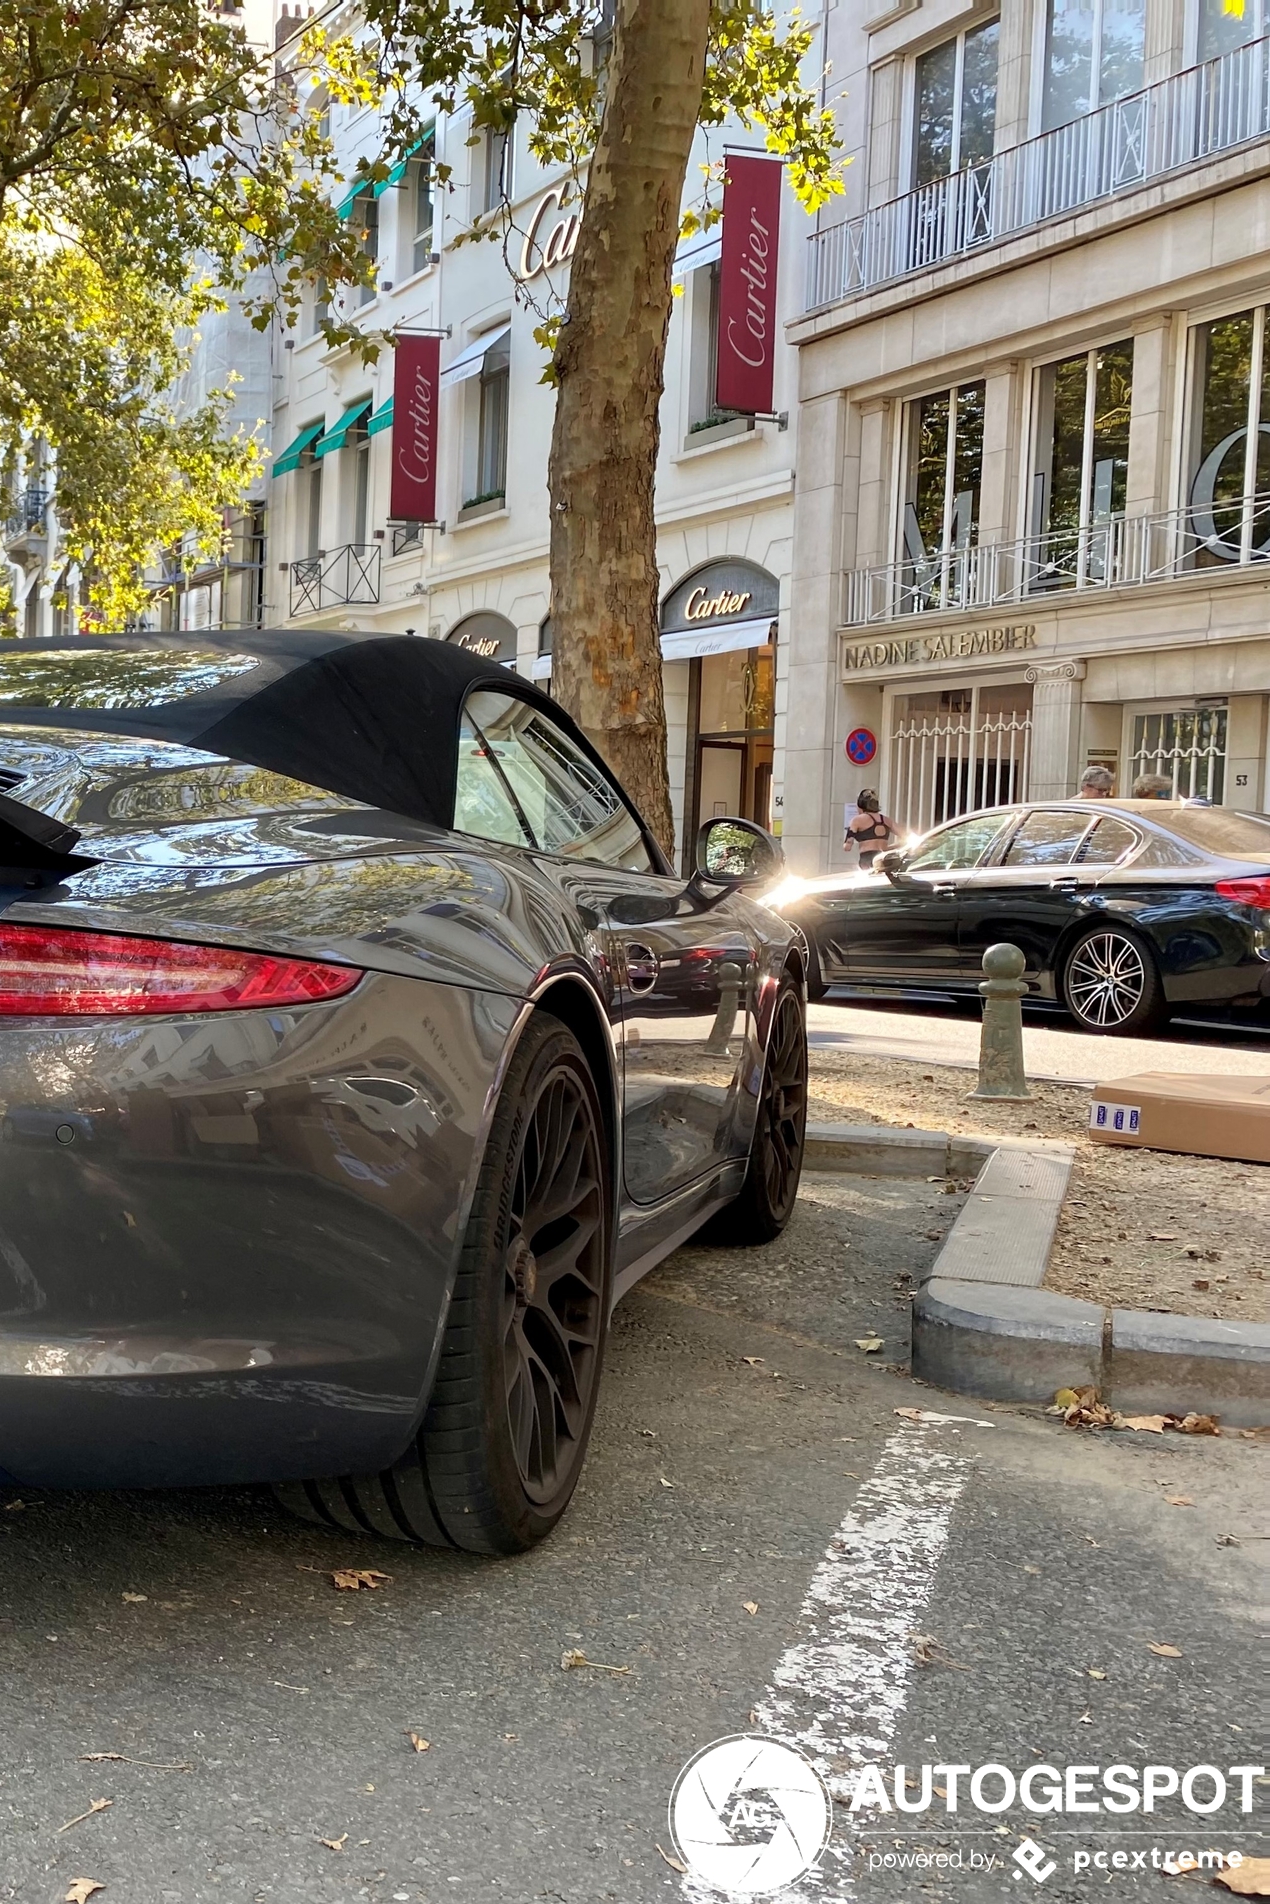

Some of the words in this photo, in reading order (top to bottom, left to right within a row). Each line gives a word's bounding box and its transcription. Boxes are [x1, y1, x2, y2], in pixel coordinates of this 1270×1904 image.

[728, 207, 769, 367] Cartier
[399, 365, 432, 483] Cartier
[684, 587, 751, 621] Cartier
[695, 640, 722, 654] Cartier
[845, 640, 920, 669] NADINE
[923, 625, 1037, 661] SALEMBIER
[1236, 775, 1247, 786] 53
[493, 1106, 525, 1250] BRIDGESTONE
